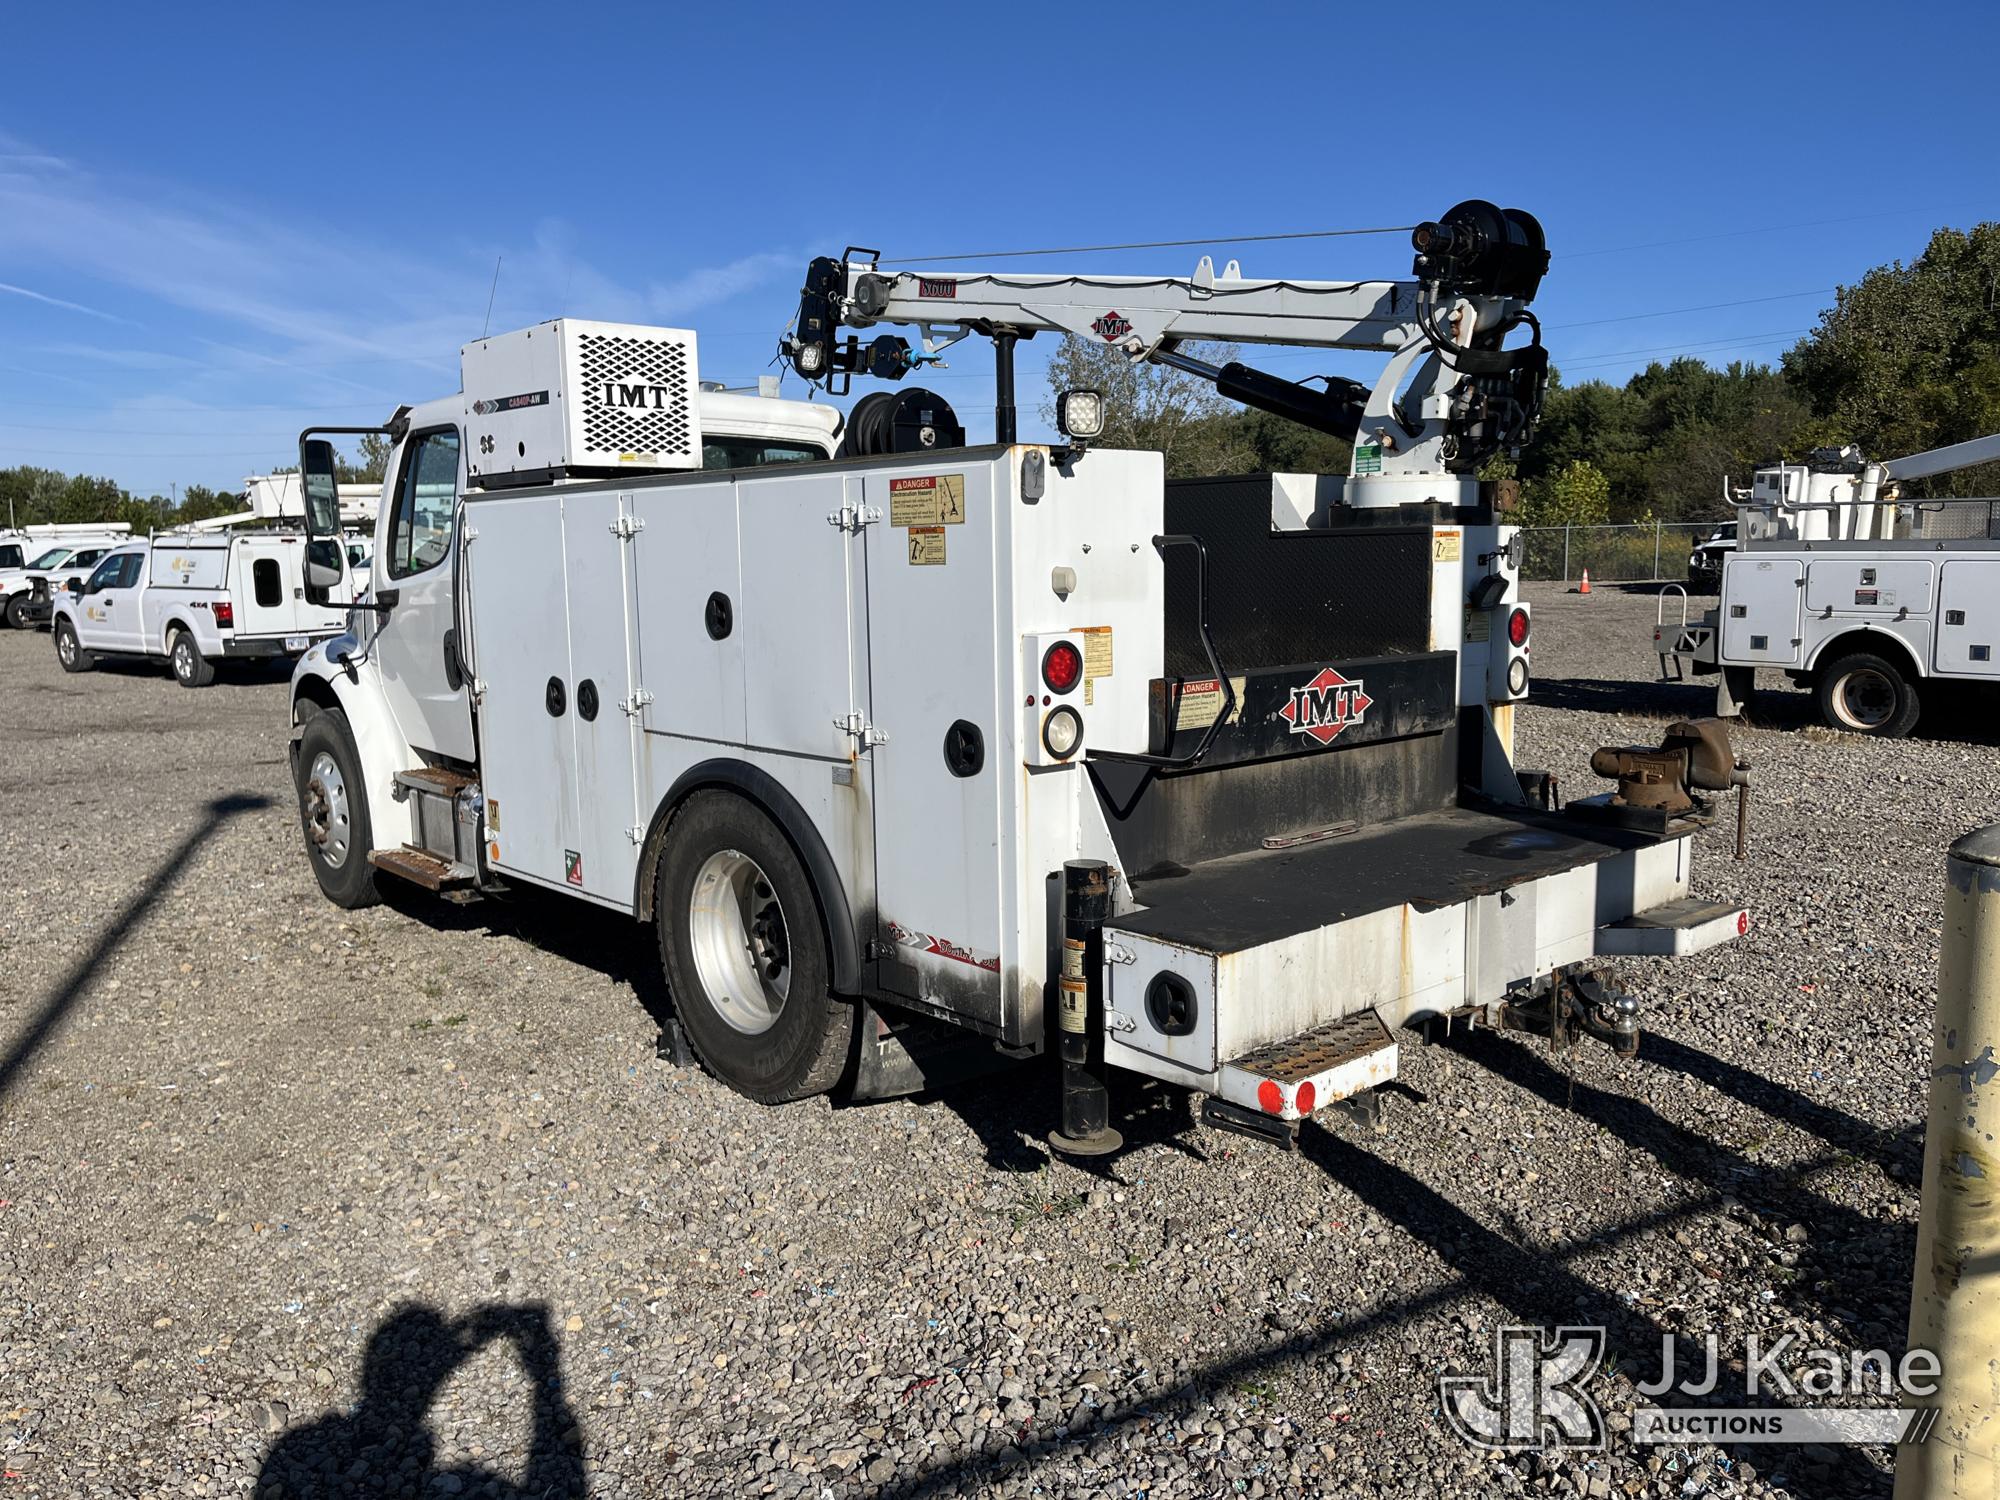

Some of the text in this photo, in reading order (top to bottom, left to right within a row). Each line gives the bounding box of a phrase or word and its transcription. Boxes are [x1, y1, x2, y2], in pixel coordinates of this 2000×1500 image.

[1093, 316, 1130, 336] IMT
[603, 382, 669, 410] IMT
[902, 478, 930, 489] DANGER
[1186, 682, 1214, 693] DANGER
[1291, 681, 1363, 731] IMT
